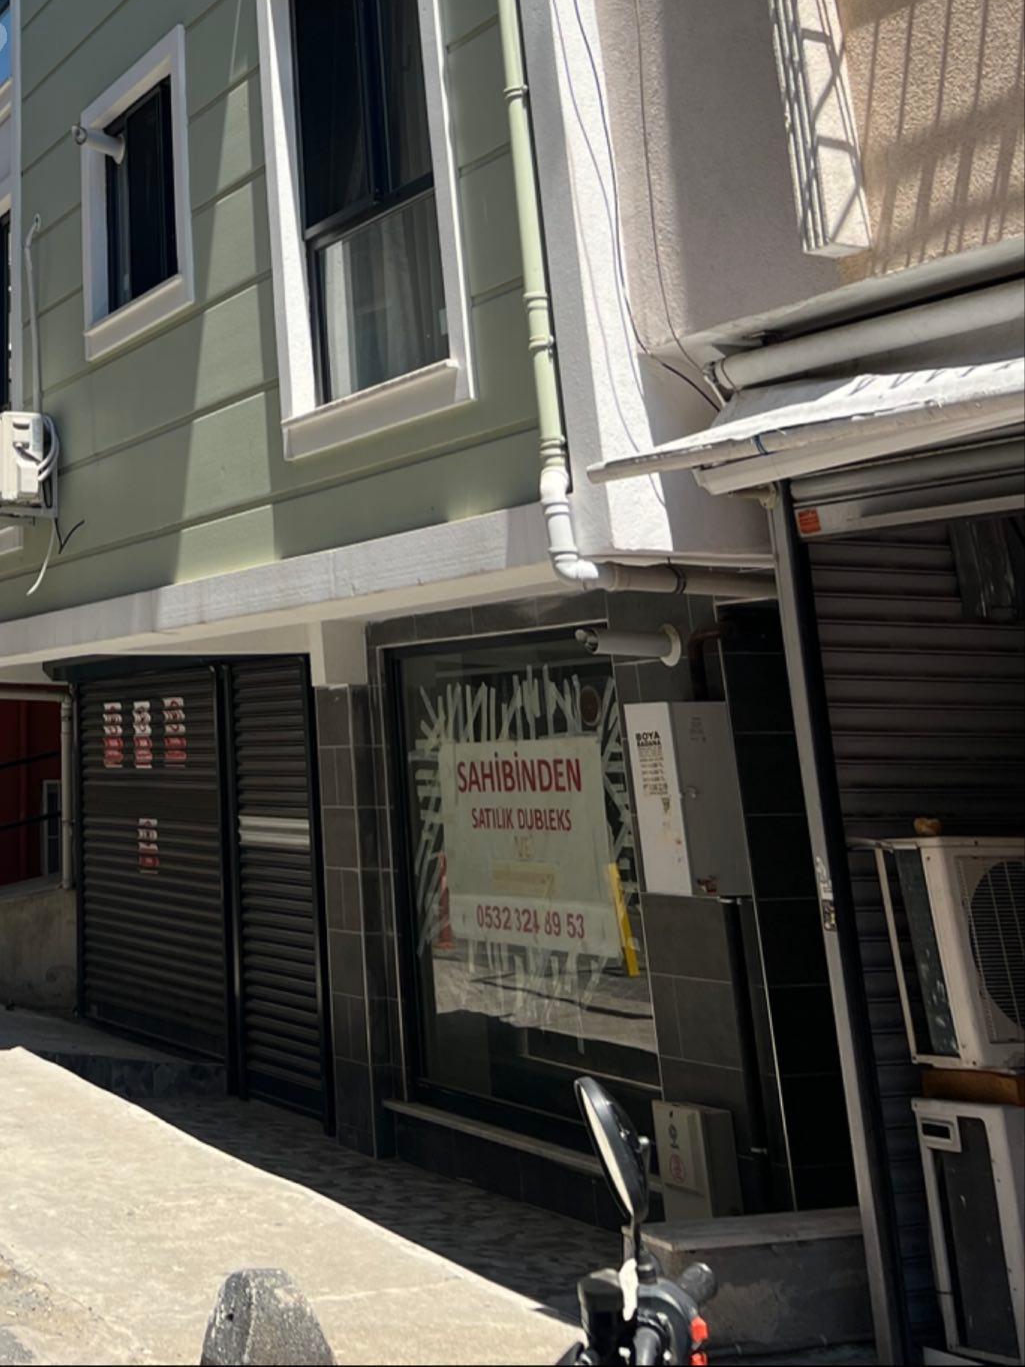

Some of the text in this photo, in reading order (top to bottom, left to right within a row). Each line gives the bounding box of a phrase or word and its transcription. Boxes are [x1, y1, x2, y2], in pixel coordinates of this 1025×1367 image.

[457, 751, 583, 792] SAHİBİNDEN
[471, 807, 514, 830] SATILIK
[476, 904, 512, 931] 0532
[566, 913, 585, 939] 53
